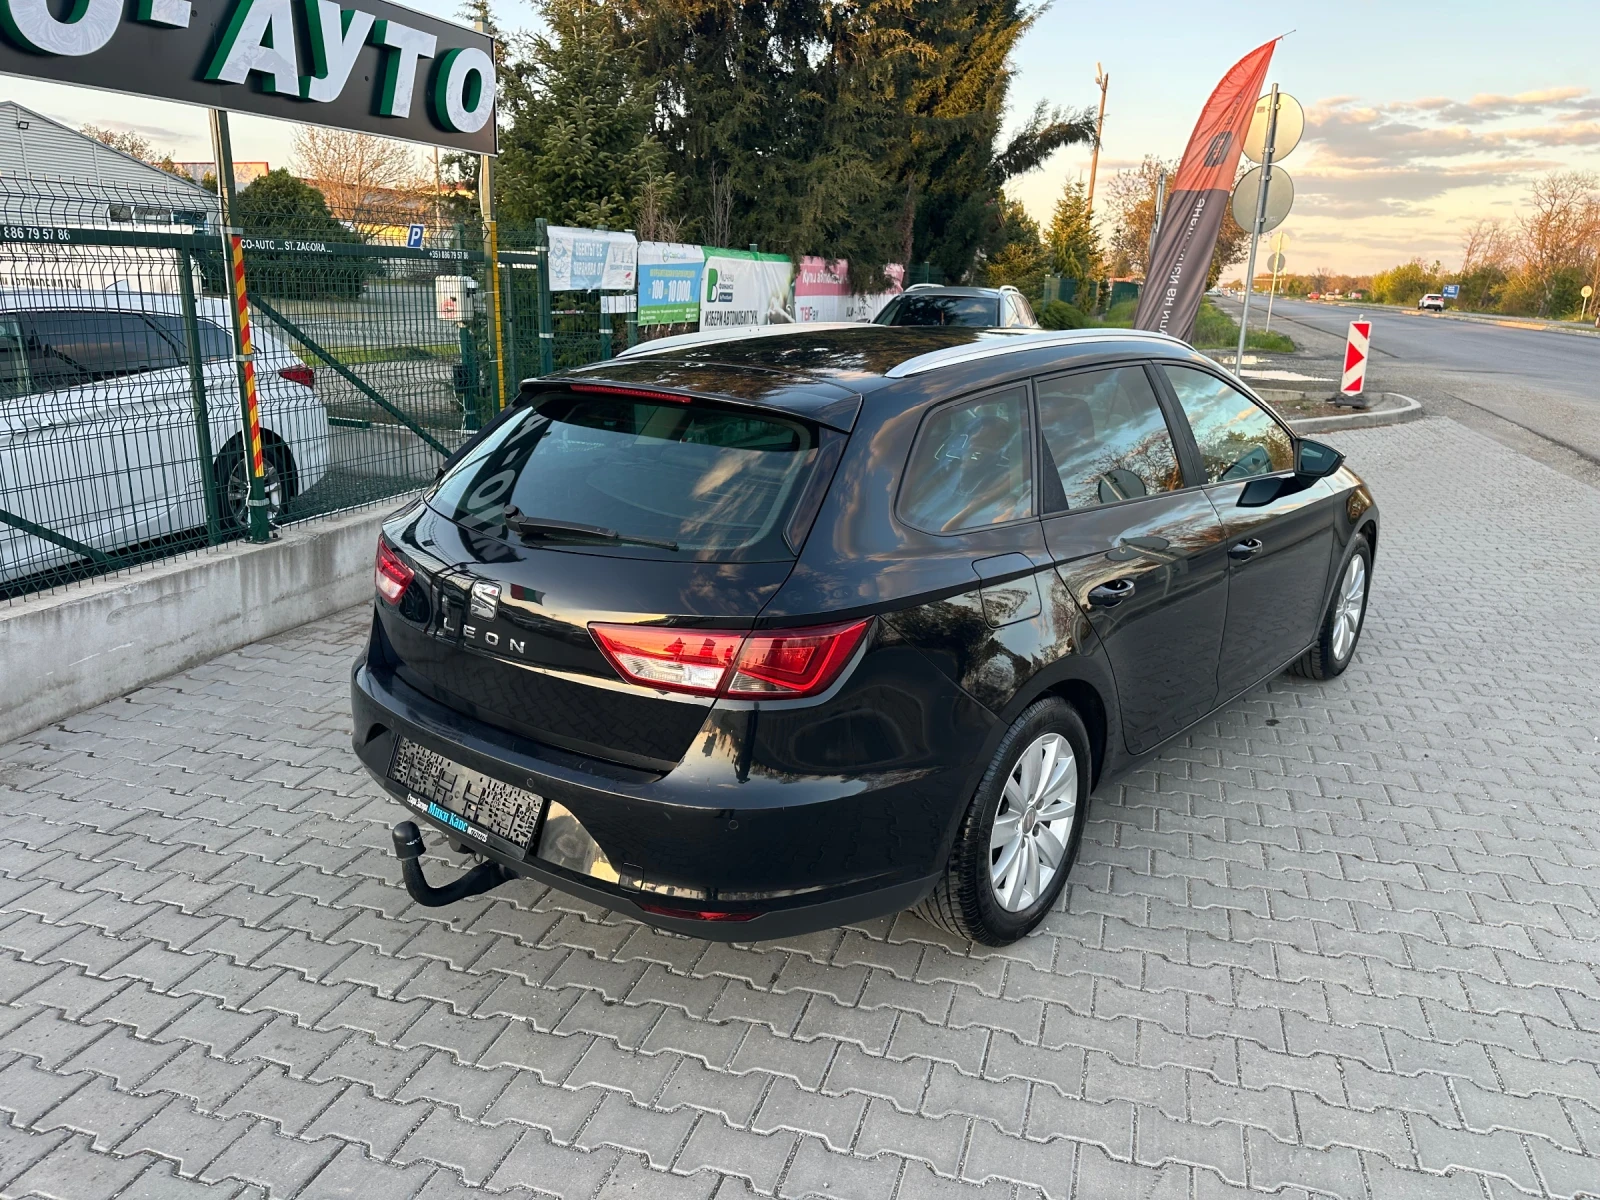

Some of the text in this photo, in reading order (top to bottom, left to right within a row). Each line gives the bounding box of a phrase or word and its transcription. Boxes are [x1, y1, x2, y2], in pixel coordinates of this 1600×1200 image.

[26, 227, 40, 239] 79
[42, 228, 54, 240] 57
[57, 229, 71, 241] 86
[410, 228, 421, 245] P
[296, 241, 326, 252] ZAGORA
[652, 280, 665, 299] 100
[1165, 288, 1177, 306] на
[443, 617, 526, 654] LEON
[427, 801, 450, 823] Мики
